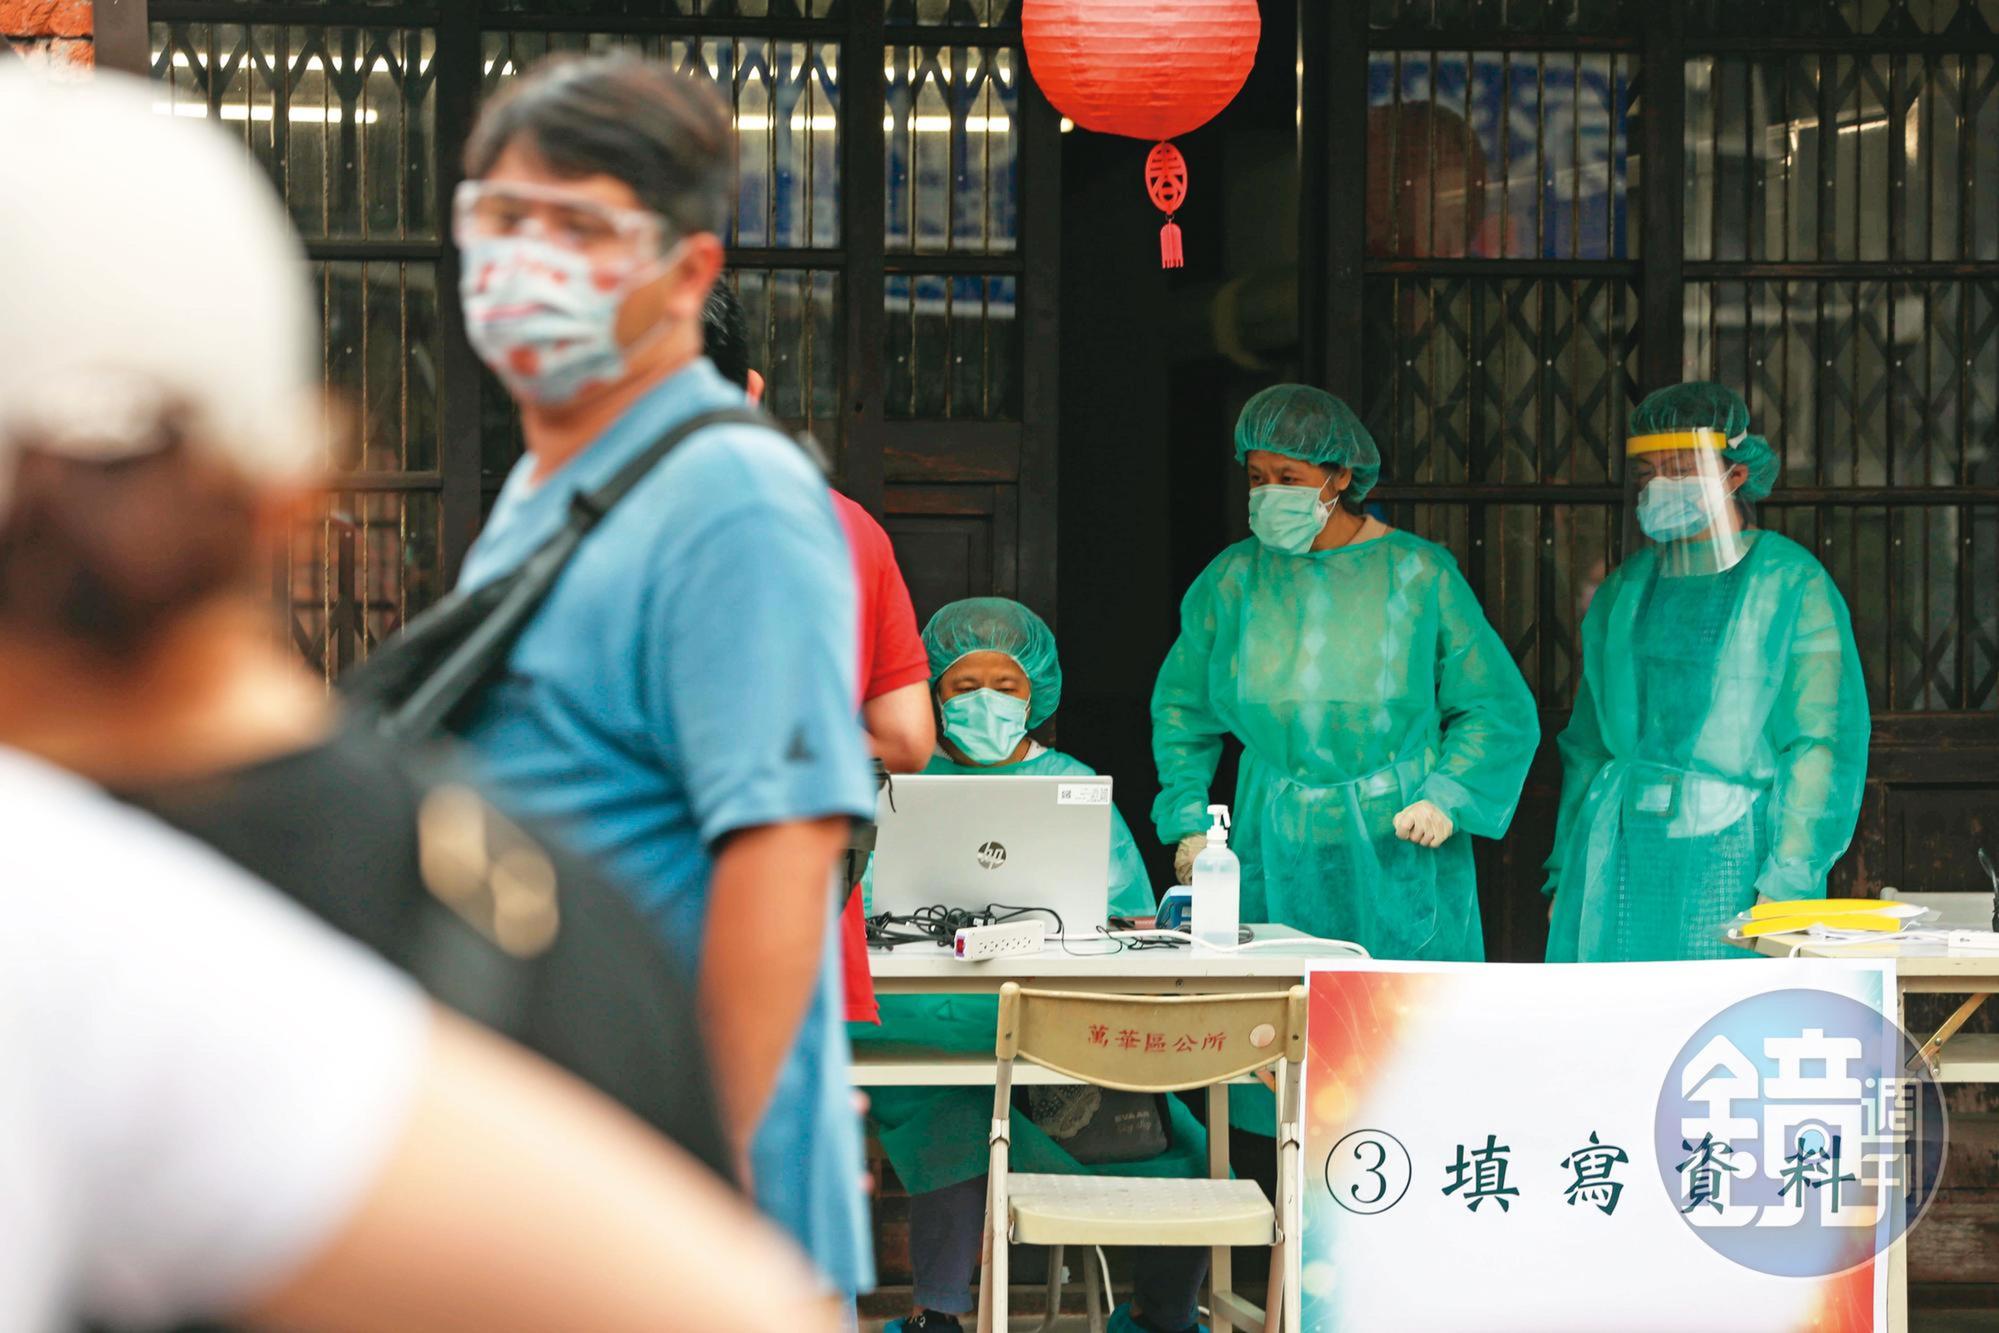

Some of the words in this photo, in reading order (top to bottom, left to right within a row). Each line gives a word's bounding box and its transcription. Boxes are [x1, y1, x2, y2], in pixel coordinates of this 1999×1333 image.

[978, 841, 1006, 870] hp
[1089, 1023, 1227, 1053] 萬華區公所
[1441, 1130, 1856, 1216] 填寫資料
